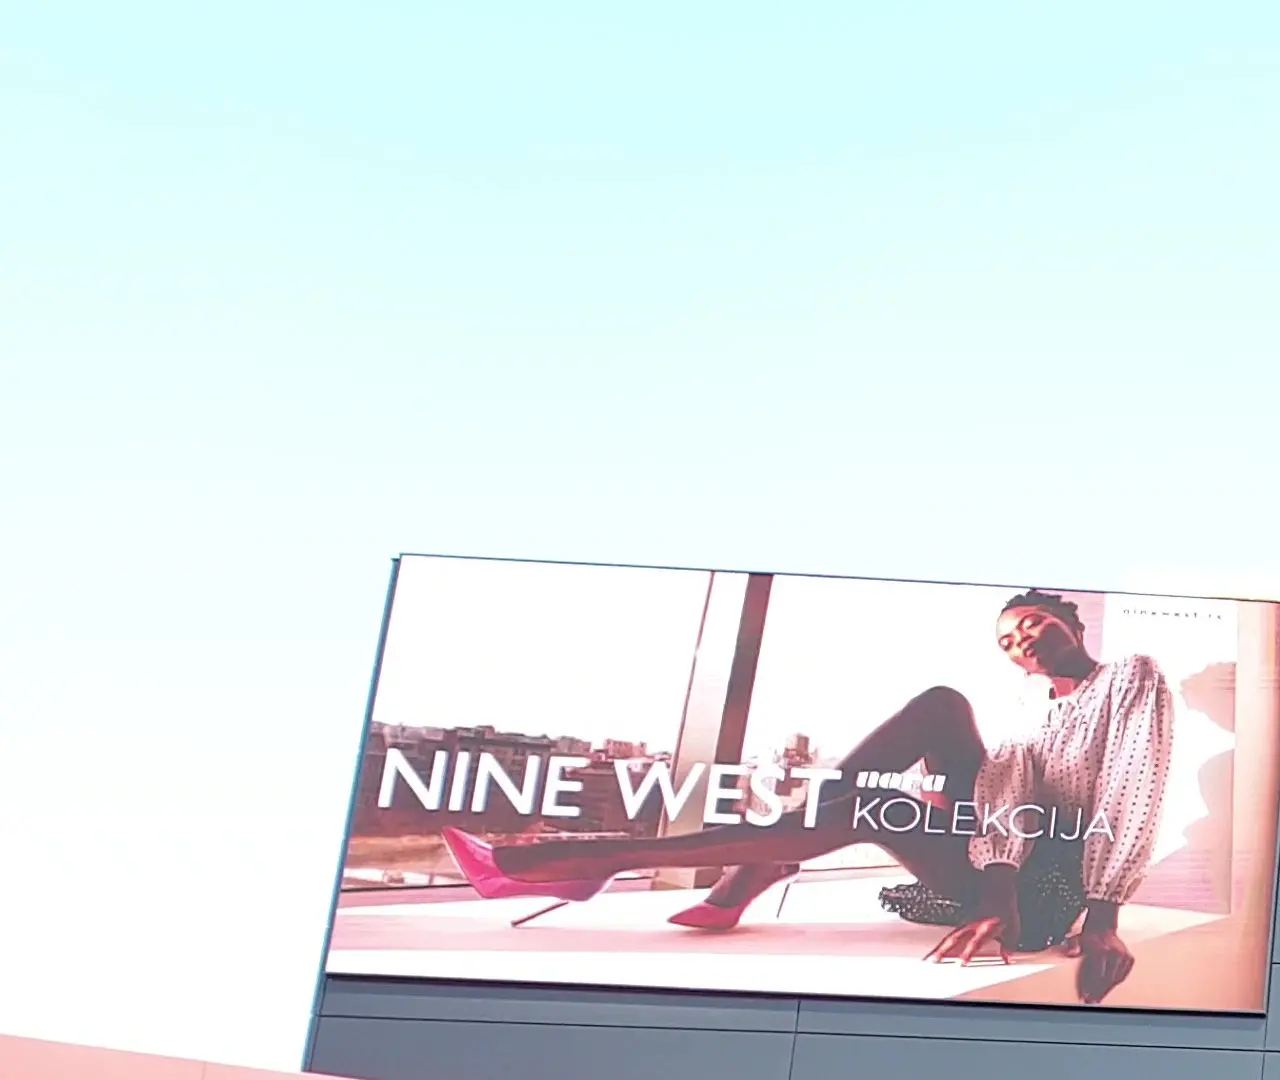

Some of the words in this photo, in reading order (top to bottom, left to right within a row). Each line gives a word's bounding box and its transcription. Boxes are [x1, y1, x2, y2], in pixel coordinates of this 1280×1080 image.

[377, 747, 592, 818] NINE
[614, 758, 842, 829] WEST
[852, 795, 1116, 842] KOLEKCIJA
